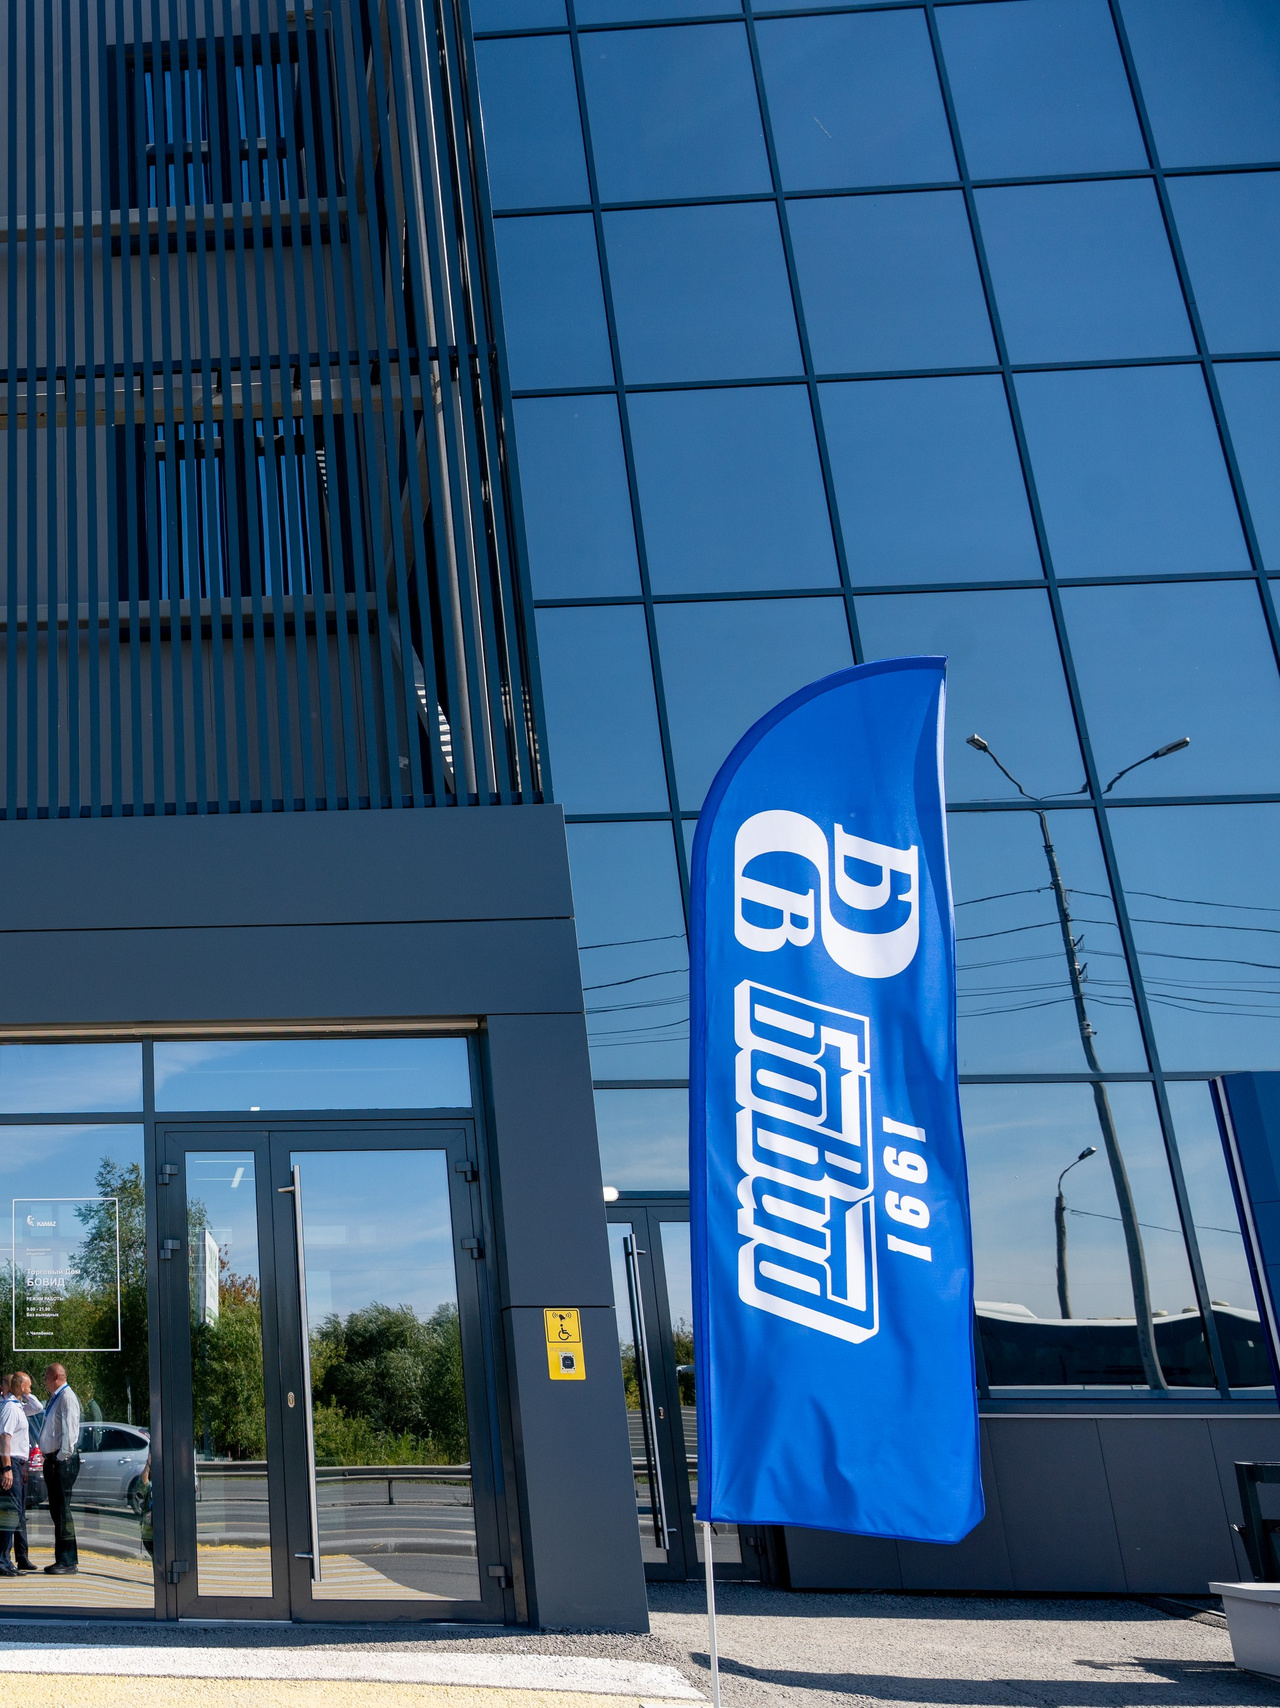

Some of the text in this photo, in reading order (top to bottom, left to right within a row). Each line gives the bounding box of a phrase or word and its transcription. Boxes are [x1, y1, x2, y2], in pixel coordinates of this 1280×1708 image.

[882, 1115, 932, 1262] 1991
[26, 1268, 81, 1276] Торговый Дом
[27, 1277, 66, 1287] БОВИД
